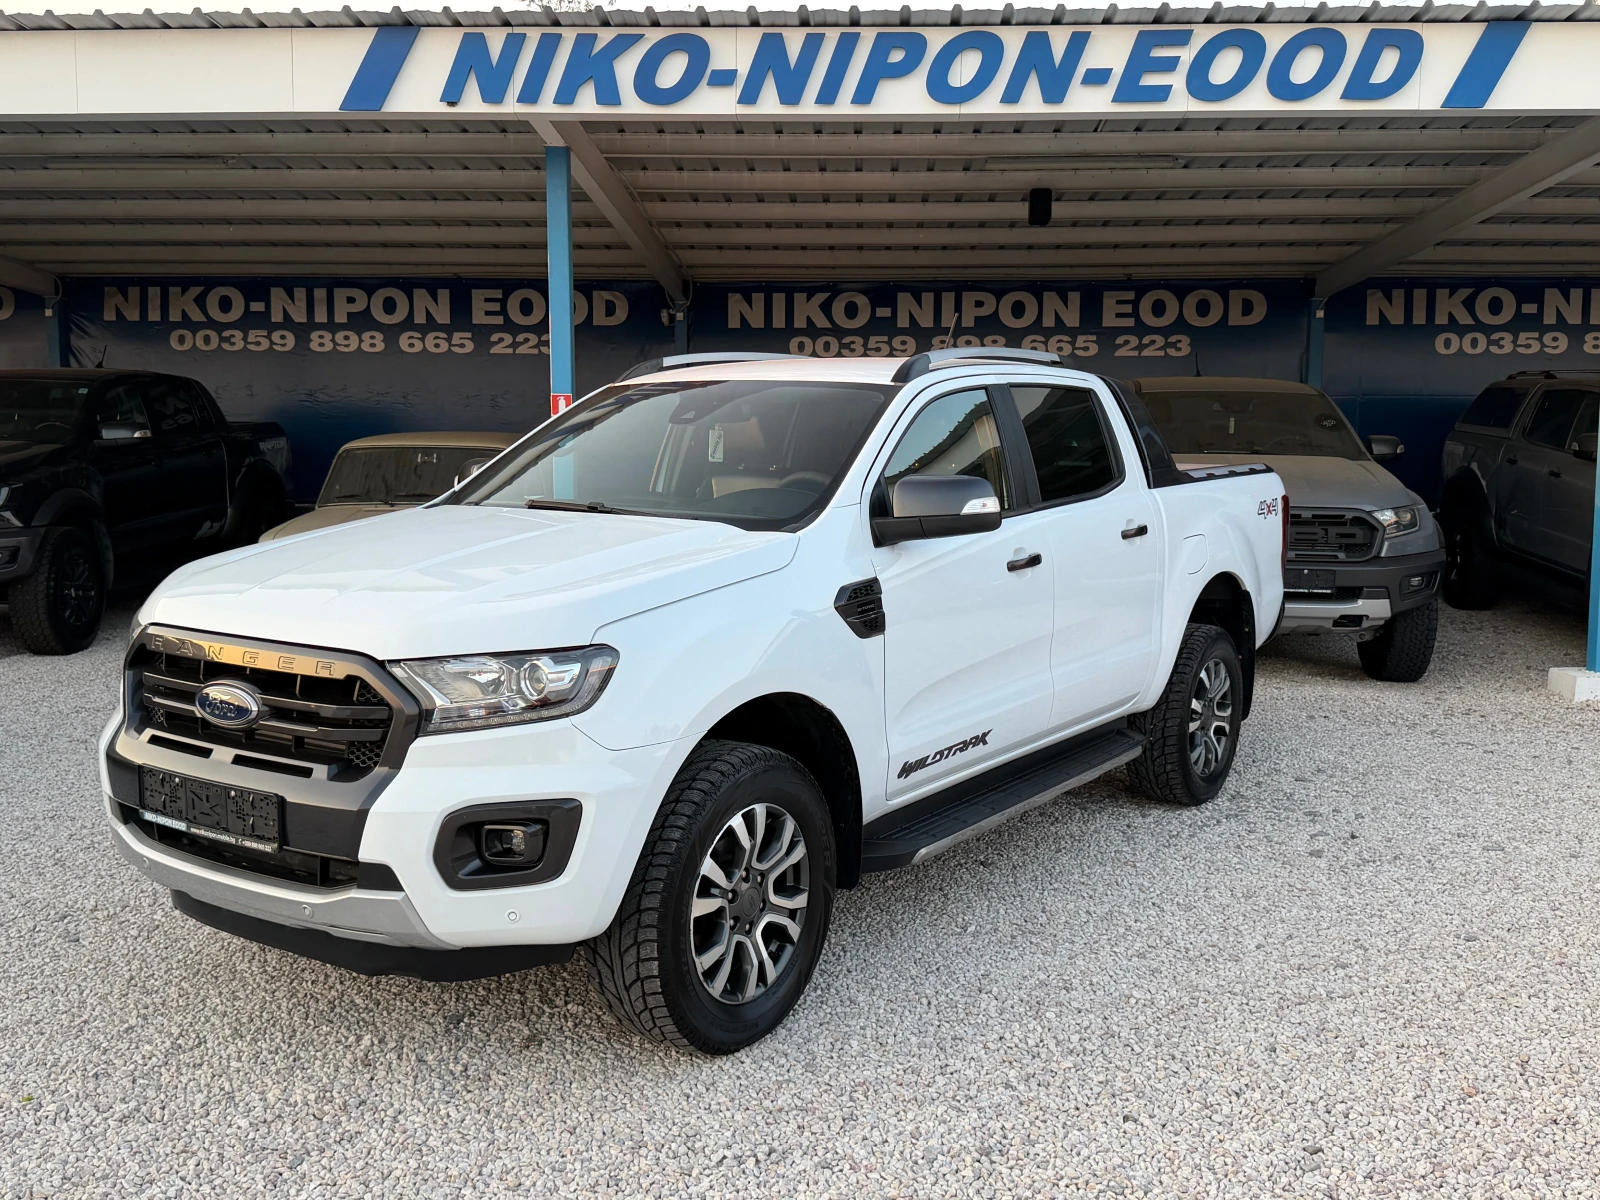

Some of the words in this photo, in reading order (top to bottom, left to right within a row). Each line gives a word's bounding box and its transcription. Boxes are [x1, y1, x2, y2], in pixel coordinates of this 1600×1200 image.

[103, 285, 452, 325] NIKO-NIPON
[727, 290, 1082, 329] NIKO-NIPON
[1102, 288, 1268, 328] EOOD
[169, 328, 295, 353] 00359
[309, 329, 385, 353] 898
[398, 330, 474, 354] 665
[788, 335, 917, 358] 00359
[1021, 334, 1099, 358] 665
[1113, 334, 1192, 357] 223
[1434, 331, 1569, 355] 00359
[152, 635, 335, 676] RANGER
[204, 692, 239, 719] Ford
[896, 728, 994, 780] WILDTRAK
